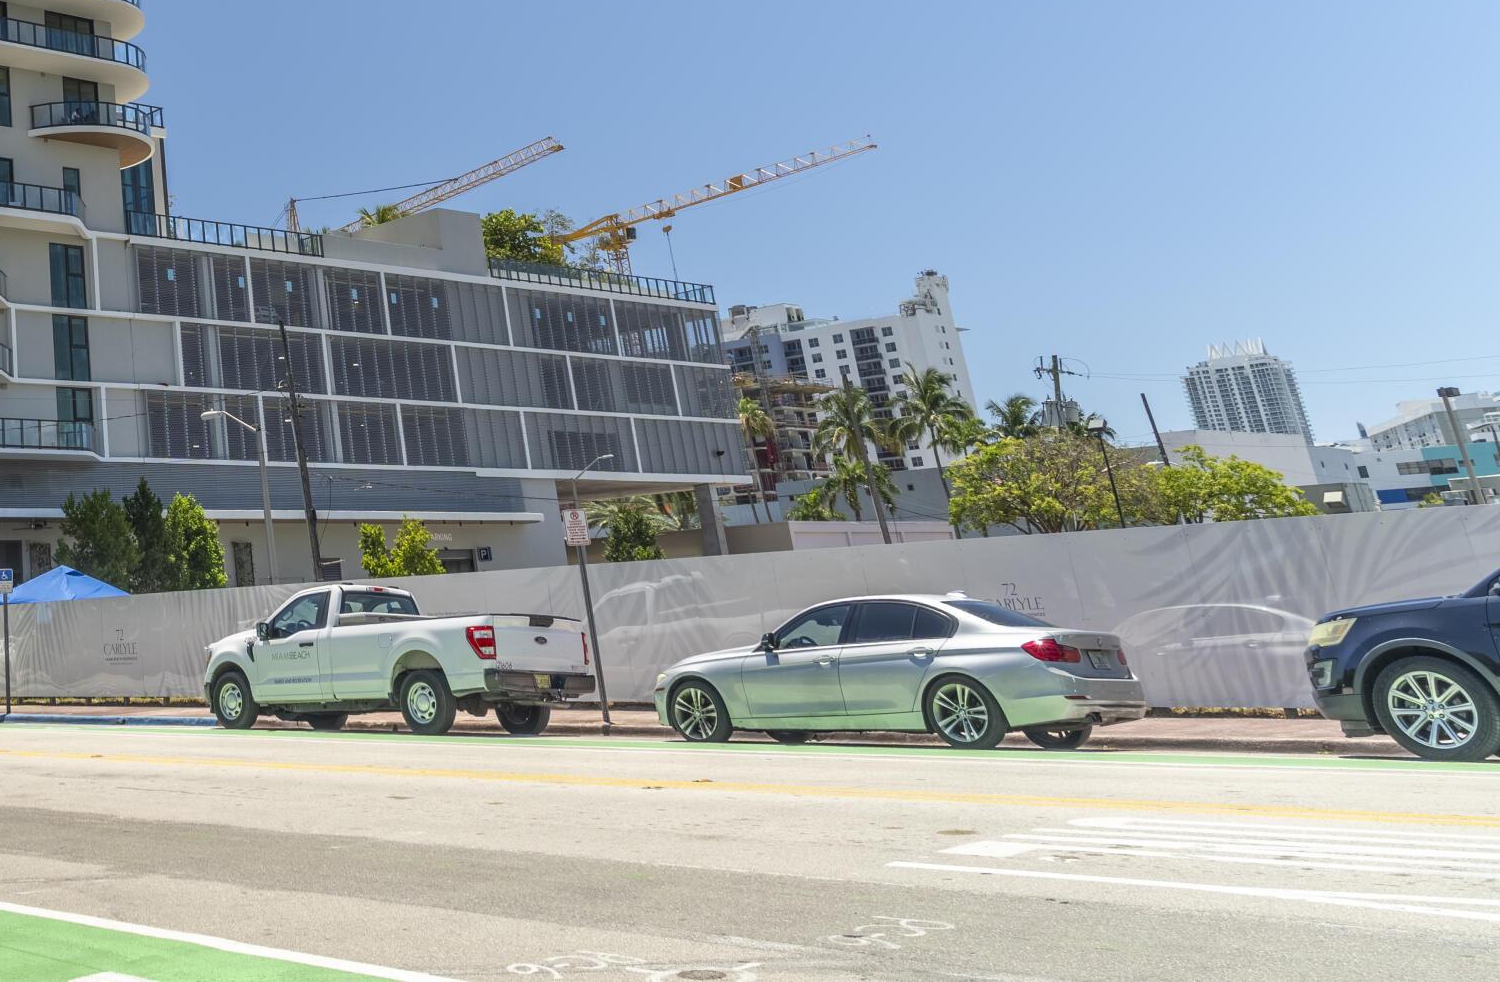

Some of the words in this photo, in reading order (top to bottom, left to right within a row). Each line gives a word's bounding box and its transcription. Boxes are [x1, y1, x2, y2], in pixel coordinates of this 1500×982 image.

[430, 533, 453, 541] ARKING
[1001, 582, 1018, 596] 72
[983, 597, 1045, 611] ARLYLE
[115, 628, 125, 641] 72
[103, 642, 138, 655] CARLYLE
